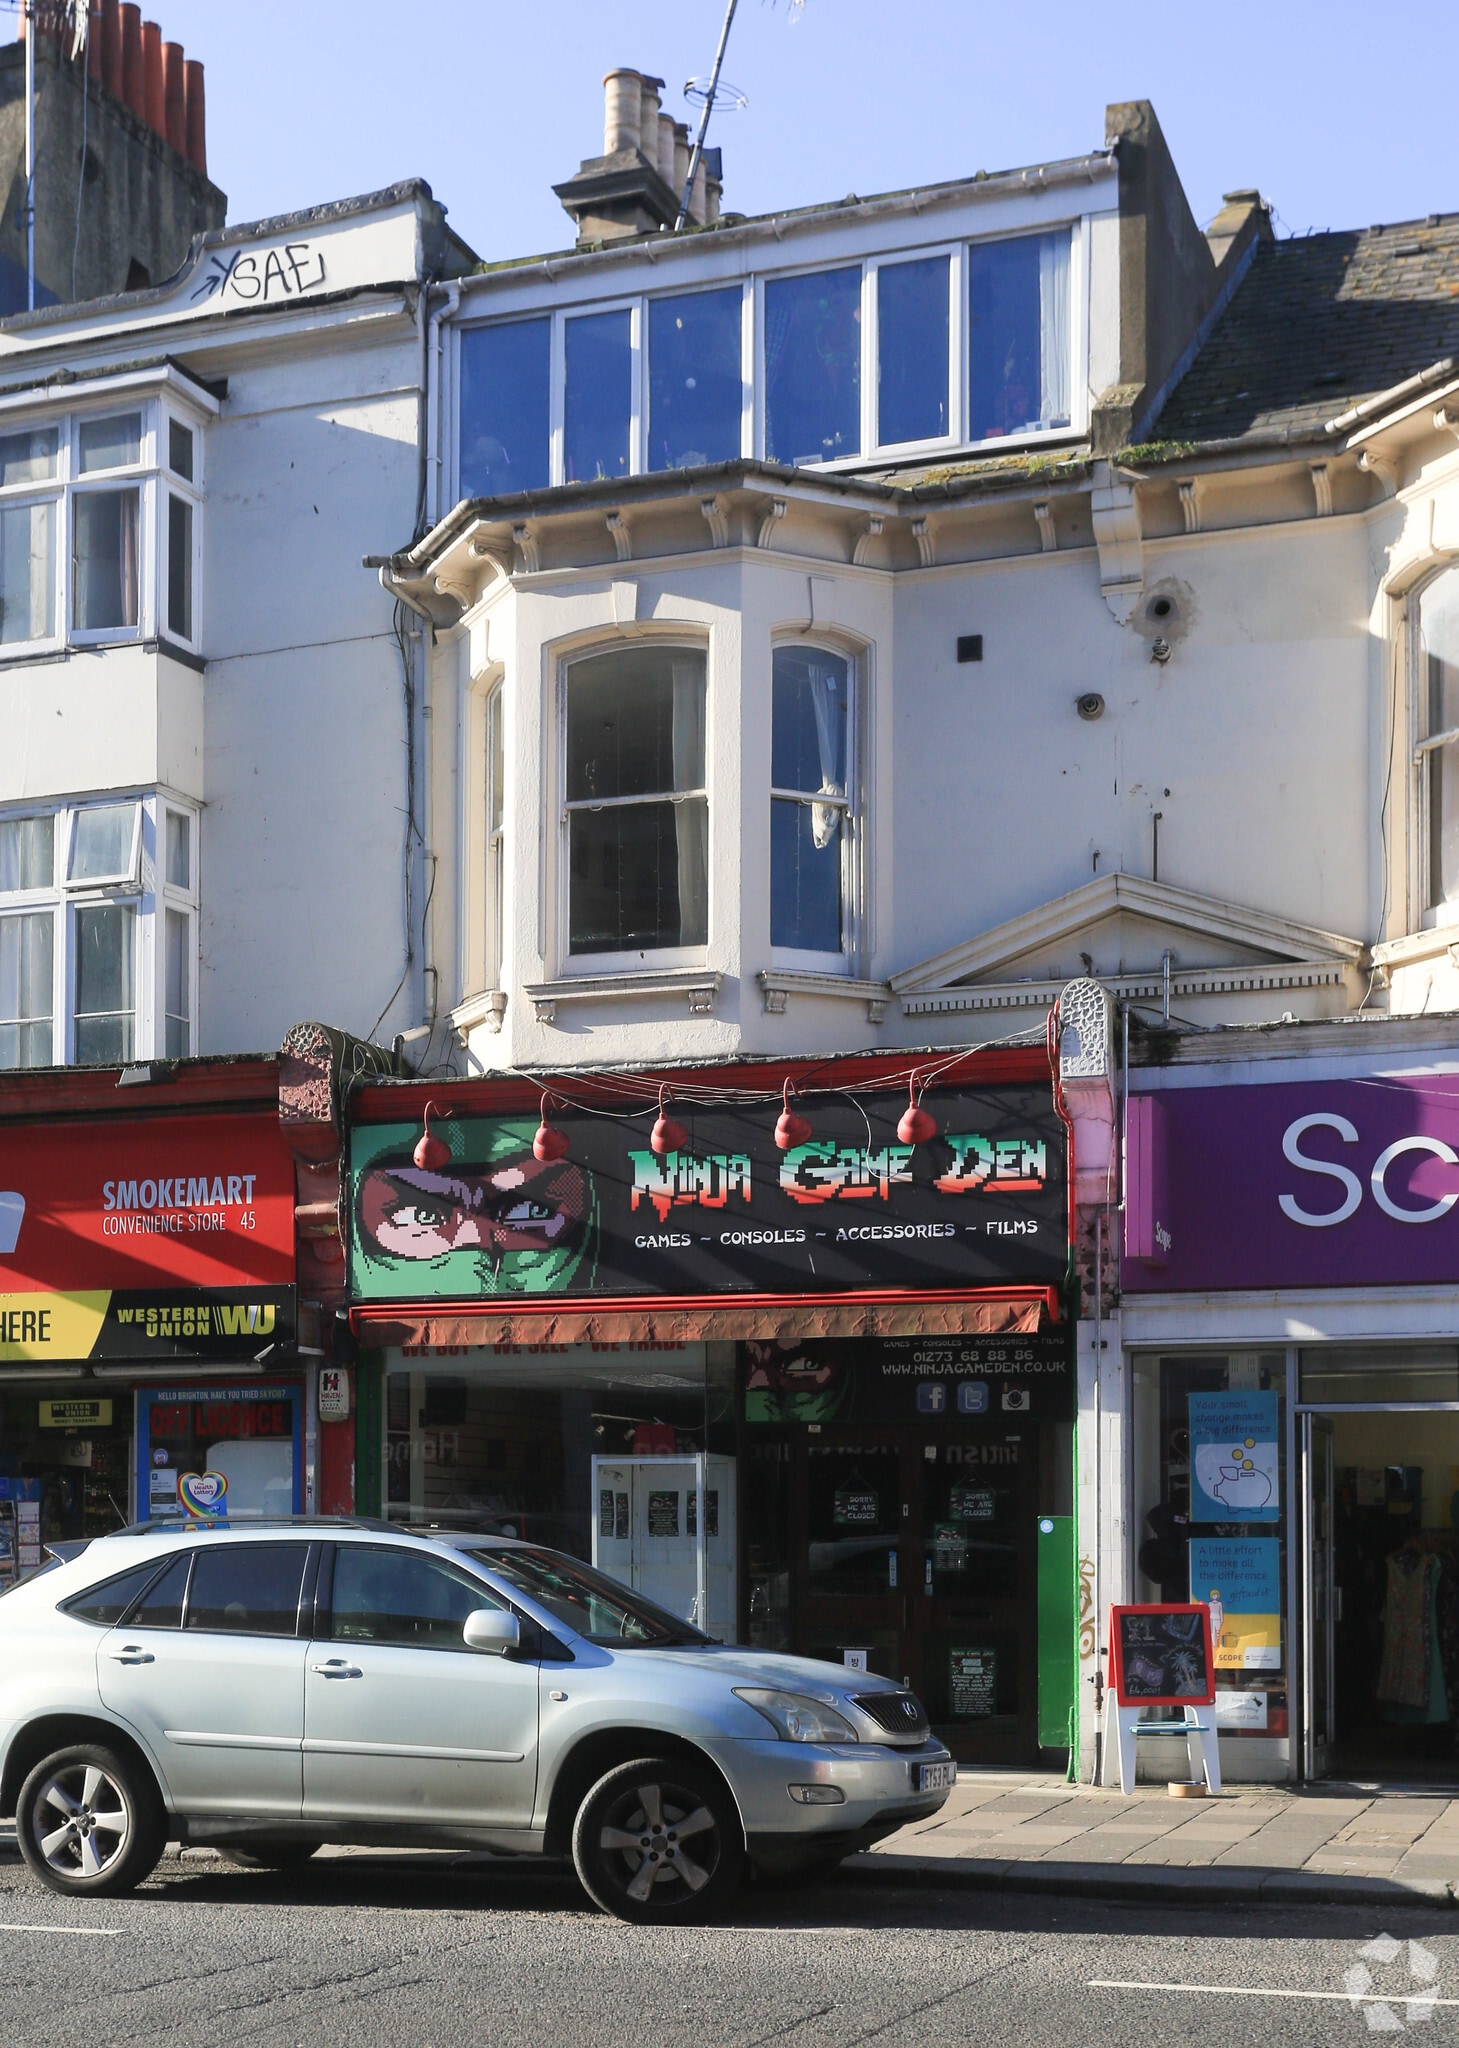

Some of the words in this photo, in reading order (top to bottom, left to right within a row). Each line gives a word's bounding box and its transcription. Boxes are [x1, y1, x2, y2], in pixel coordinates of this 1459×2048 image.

[103, 1175, 257, 1211] SMOKEMART
[103, 1214, 183, 1235] CONVENIENCE
[188, 1212, 226, 1232] STORE
[240, 1211, 256, 1230] 45
[634, 1233, 692, 1249] GAMES
[720, 1229, 806, 1245] CONSOLES
[835, 1223, 956, 1243] ACCESSORIES
[986, 1219, 1039, 1236] FILMS
[117, 1307, 210, 1323] WESTERN
[221, 1304, 276, 1335] WU
[146, 1321, 210, 1337] UNION
[922, 1339, 962, 1347] CONSOLES
[974, 1338, 1029, 1346] ACCESSORIES
[913, 1351, 953, 1362] 01273
[960, 1351, 980, 1361] 68
[987, 1350, 1006, 1361] 88
[1014, 1350, 1034, 1360] 86
[882, 1361, 1066, 1376] WWW.NINJAGAMEDEN.CO.UK
[158, 1392, 177, 1400] HELLO
[177, 1391, 210, 1400] BRIGHTON,
[210, 1391, 226, 1400] HAVE
[227, 1390, 240, 1399] YOU
[240, 1390, 259, 1399] TRIED
[53, 1403, 90, 1411] WESTERN
[1196, 1401, 1217, 1409] Your
[1221, 1400, 1248, 1409] small
[151, 1404, 189, 1436] OFF
[195, 1403, 284, 1436] LICENCE
[1196, 1414, 1230, 1423] change
[1233, 1412, 1265, 1421] makes
[1205, 1426, 1219, 1436] big
[1222, 1424, 1271, 1434] difference
[977, 1500, 993, 1508] ARE
[1199, 1546, 1206, 1554] A
[1209, 1545, 1232, 1555] little
[1234, 1545, 1262, 1554] effort
[1199, 1559, 1208, 1567] to
[1212, 1558, 1238, 1568] make
[1241, 1558, 1254, 1567] all
[1199, 1571, 1215, 1580] the
[1218, 1570, 1268, 1580] difference
[925, 1767, 941, 1788] EY53
